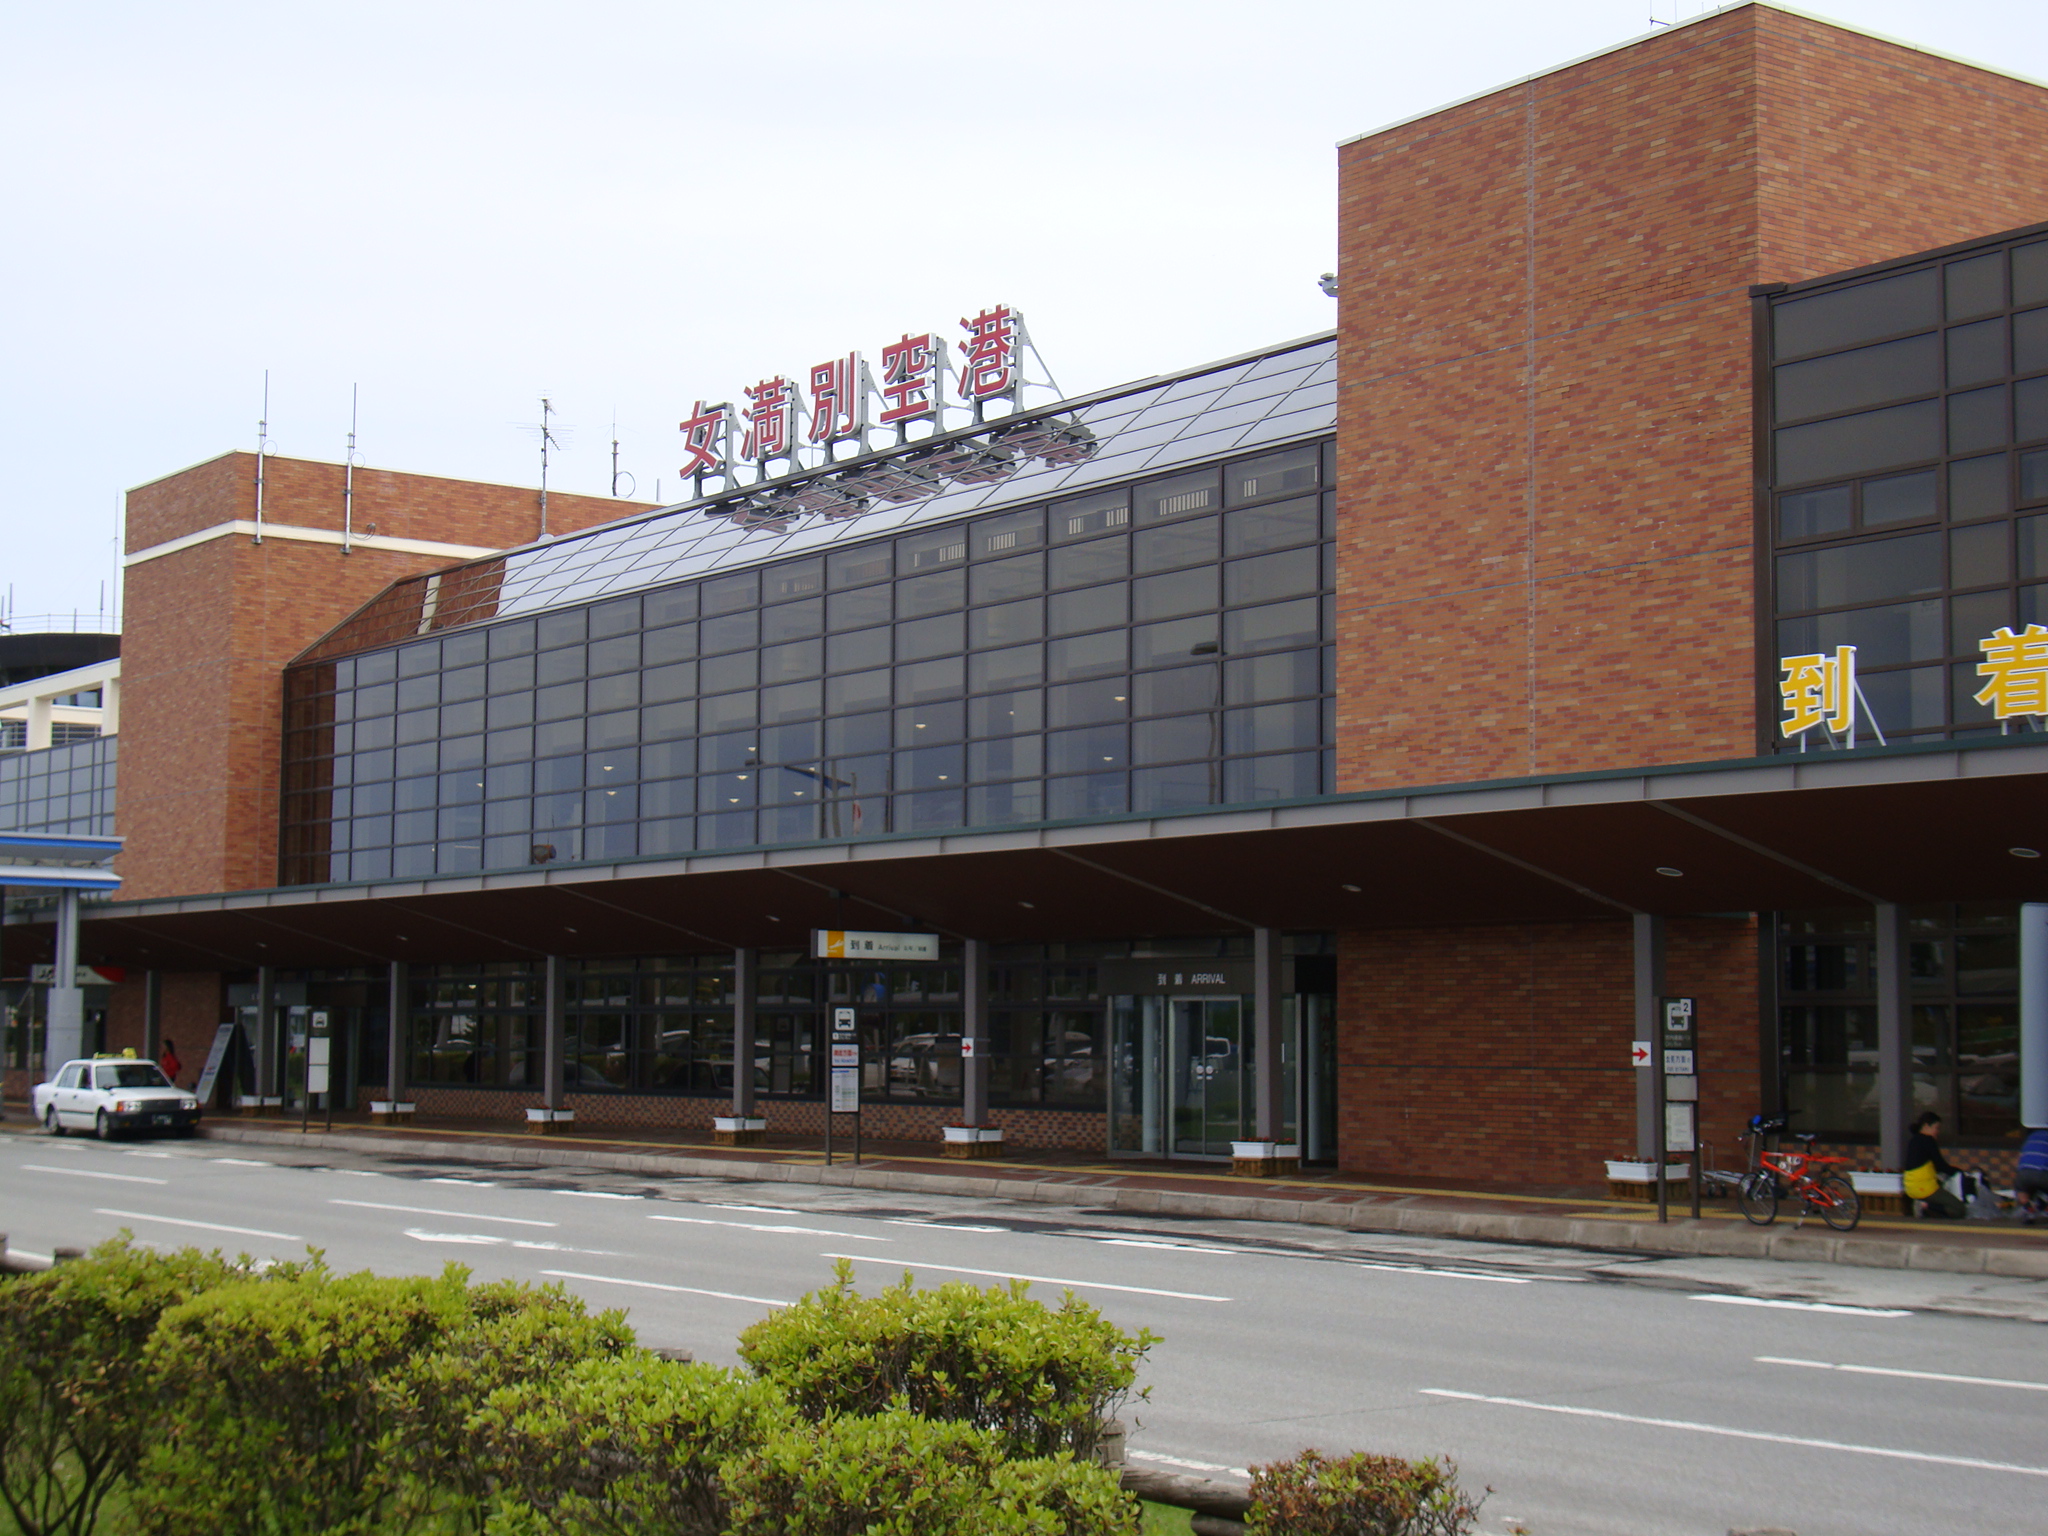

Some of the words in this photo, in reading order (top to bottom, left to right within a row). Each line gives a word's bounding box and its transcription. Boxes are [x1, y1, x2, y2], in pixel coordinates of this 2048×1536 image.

[679, 303, 1017, 480] 女満別空港
[1780, 623, 2048, 739] 到着
[1190, 973, 1226, 985] ARRIVAL
[1683, 1002, 1689, 1012] 2
